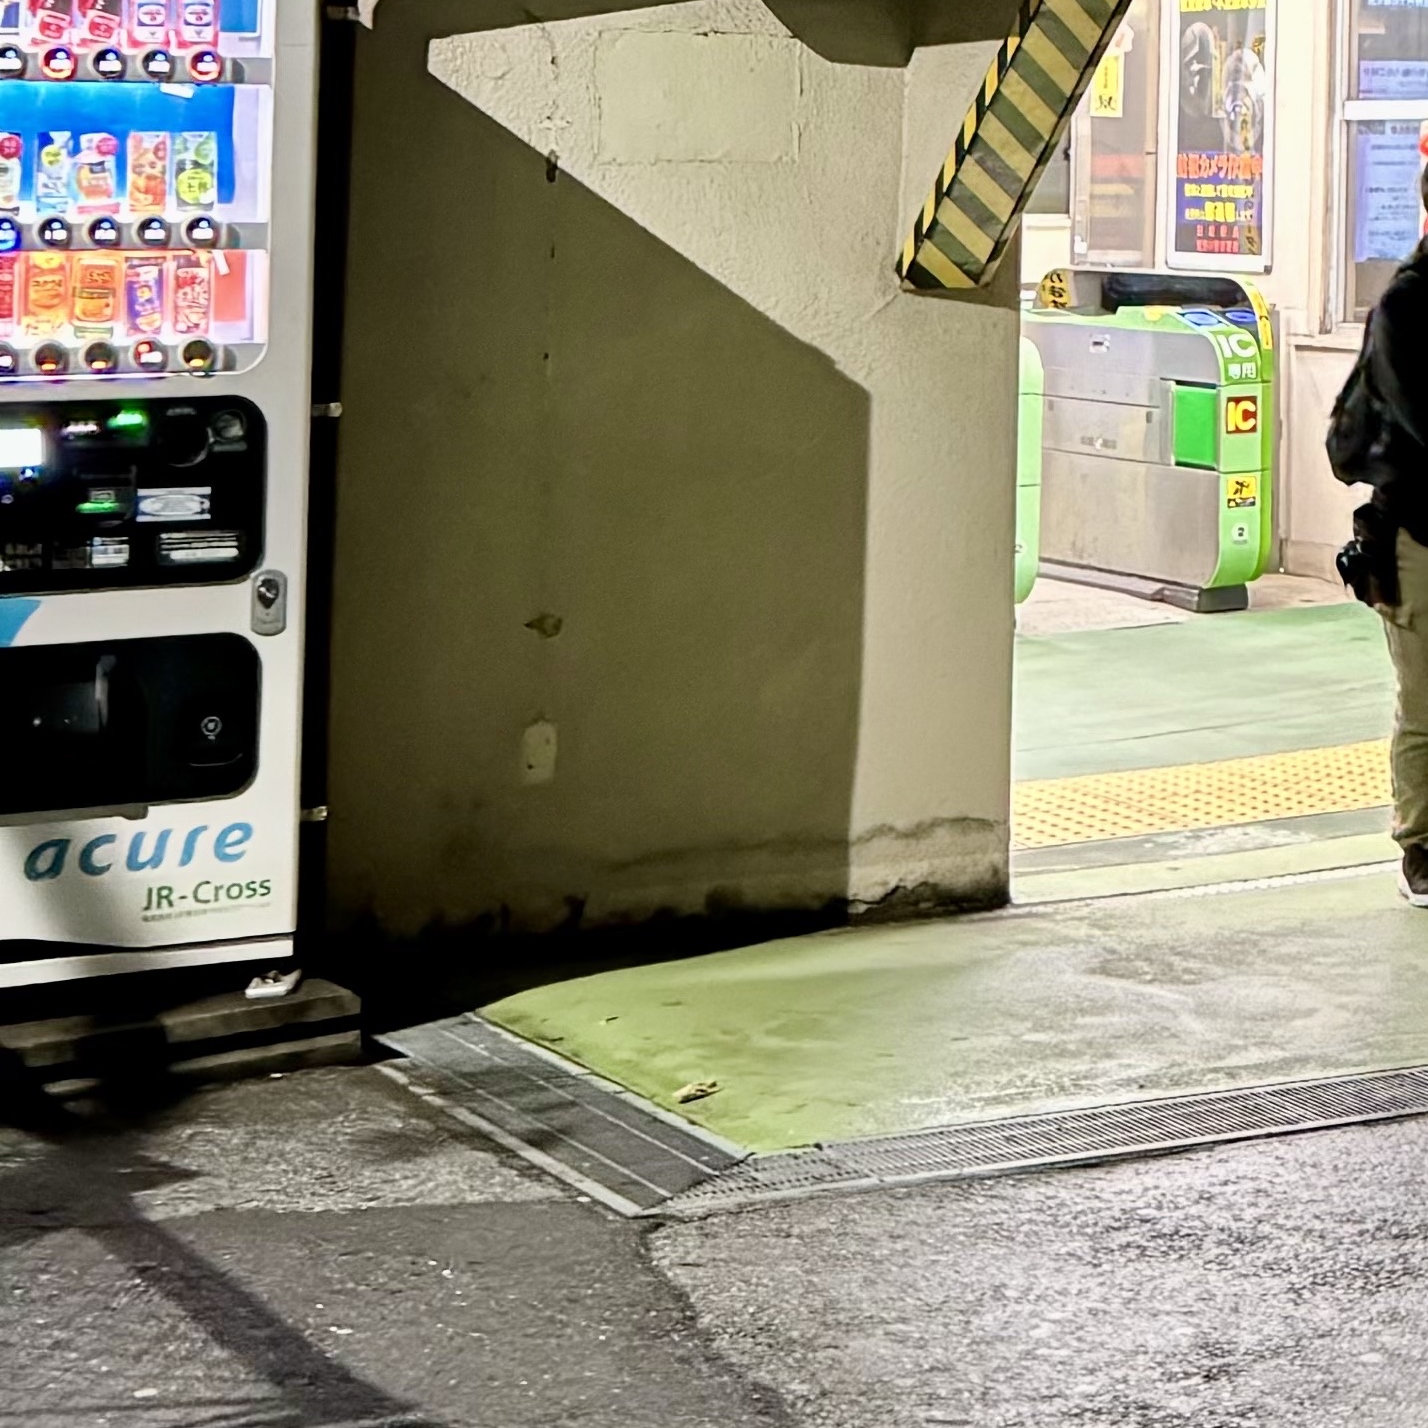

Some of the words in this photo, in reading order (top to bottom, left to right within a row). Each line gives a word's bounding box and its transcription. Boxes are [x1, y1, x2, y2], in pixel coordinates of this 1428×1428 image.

[1218, 333, 1257, 359] IC
[1227, 400, 1257, 433] IC
[24, 822, 254, 882] acure
[143, 878, 272, 912] JR-Cross
